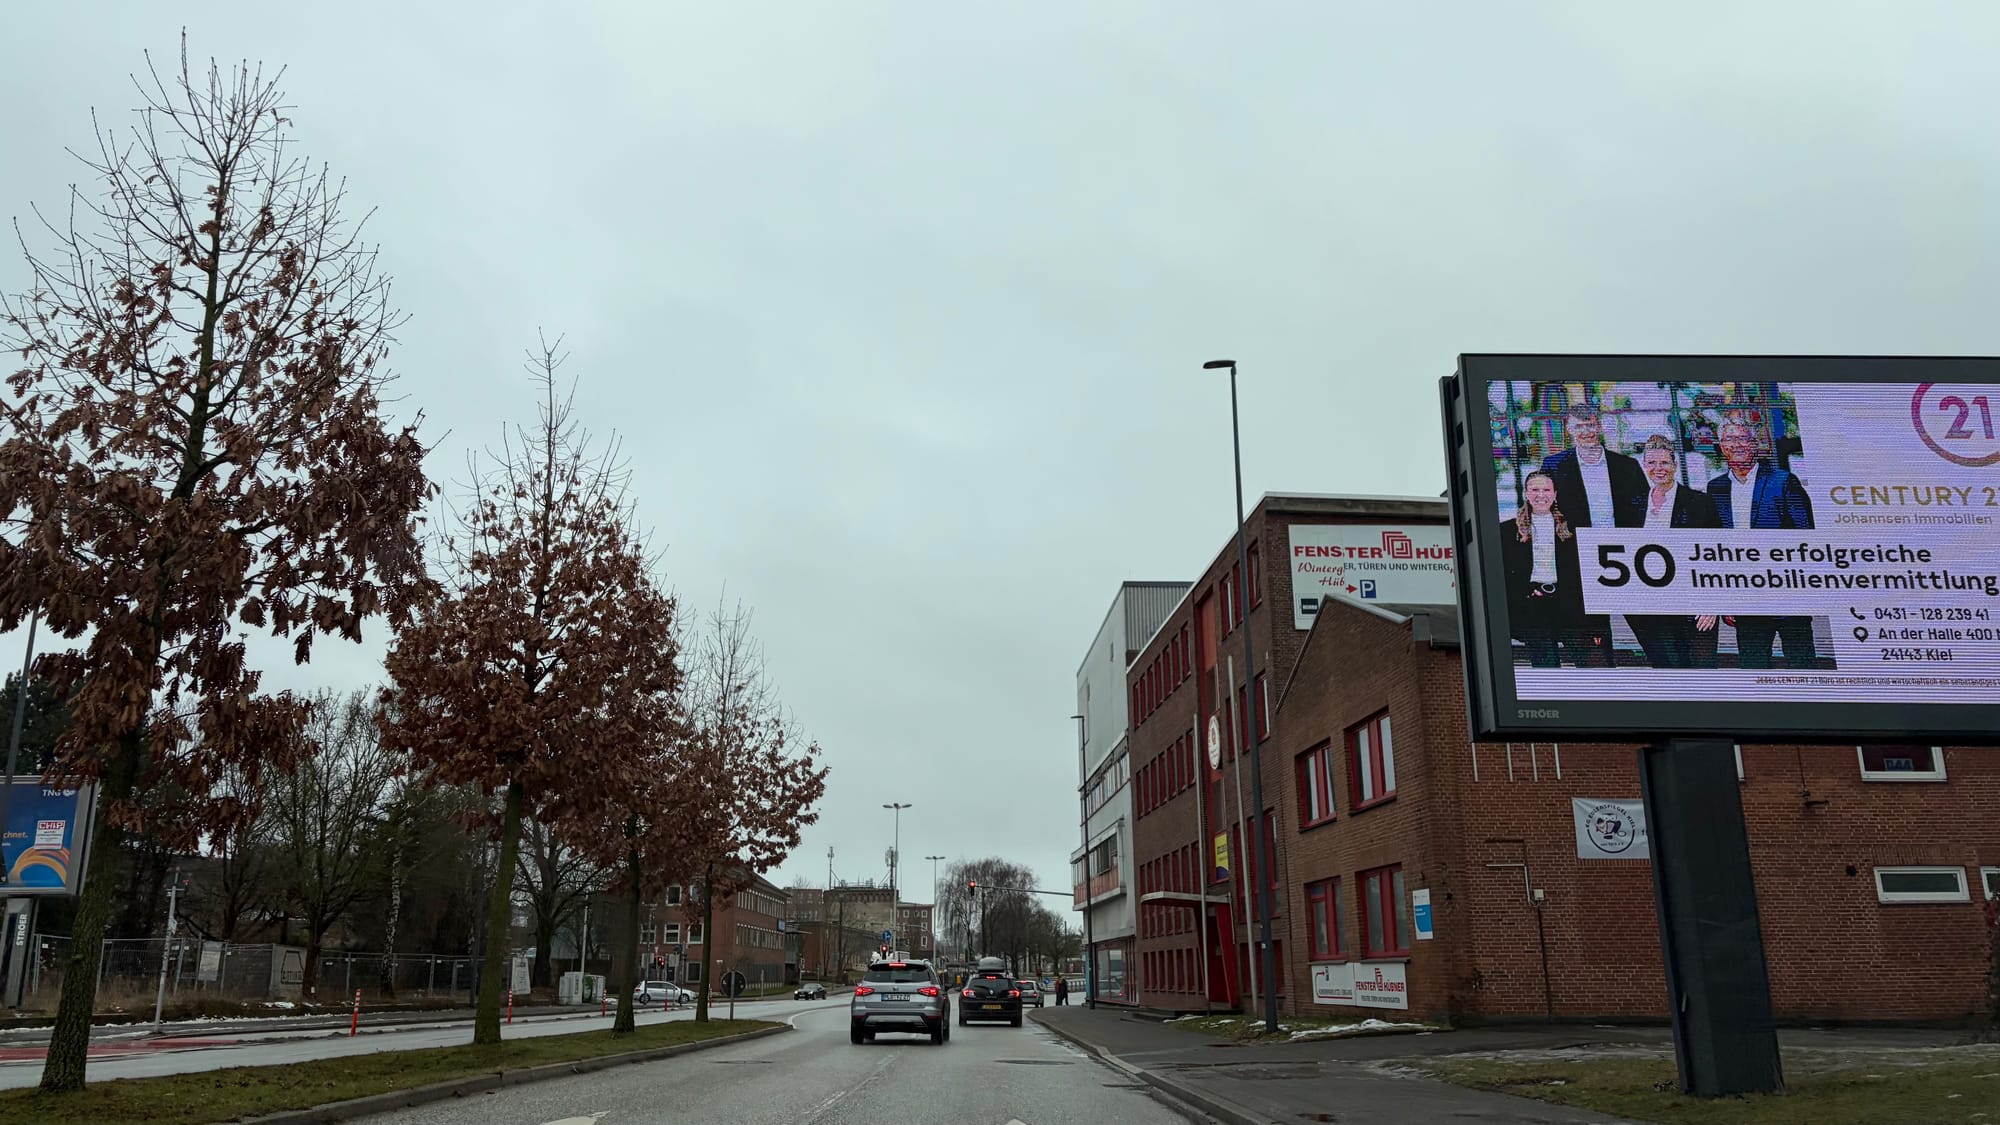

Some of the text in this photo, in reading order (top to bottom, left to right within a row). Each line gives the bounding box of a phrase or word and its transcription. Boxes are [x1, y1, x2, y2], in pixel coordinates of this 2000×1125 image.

[1939, 395, 1995, 440] 21
[1829, 485, 2000, 507] CENTURY 2
[1834, 513, 1993, 525] Johannsen Immobilien
[1294, 546, 1383, 559] FENSTER
[1688, 543, 1932, 569] Jahre erfolgreiche
[1358, 562, 1386, 571] TÜREN
[1387, 563, 1408, 571] UND
[1410, 563, 1450, 571] WINTERG
[1597, 543, 1676, 588] 50
[1691, 568, 2000, 596] Immobilienvermittlung
[1361, 580, 1374, 598] P
[1874, 607, 1907, 620] 0431
[1920, 607, 1943, 621] 128
[1947, 608, 1972, 621] 239
[1975, 608, 1990, 621] 41
[1878, 628, 1897, 640] An
[1900, 628, 1923, 640] der
[1928, 628, 1962, 640] Halle
[1966, 628, 1993, 641] 400
[1881, 648, 1953, 661] 24143 Kiel
[1517, 708, 1560, 719] STRÖER
[38, 821, 64, 829] CHIP
[1355, 979, 1405, 992] FENSTER HÜBNER
